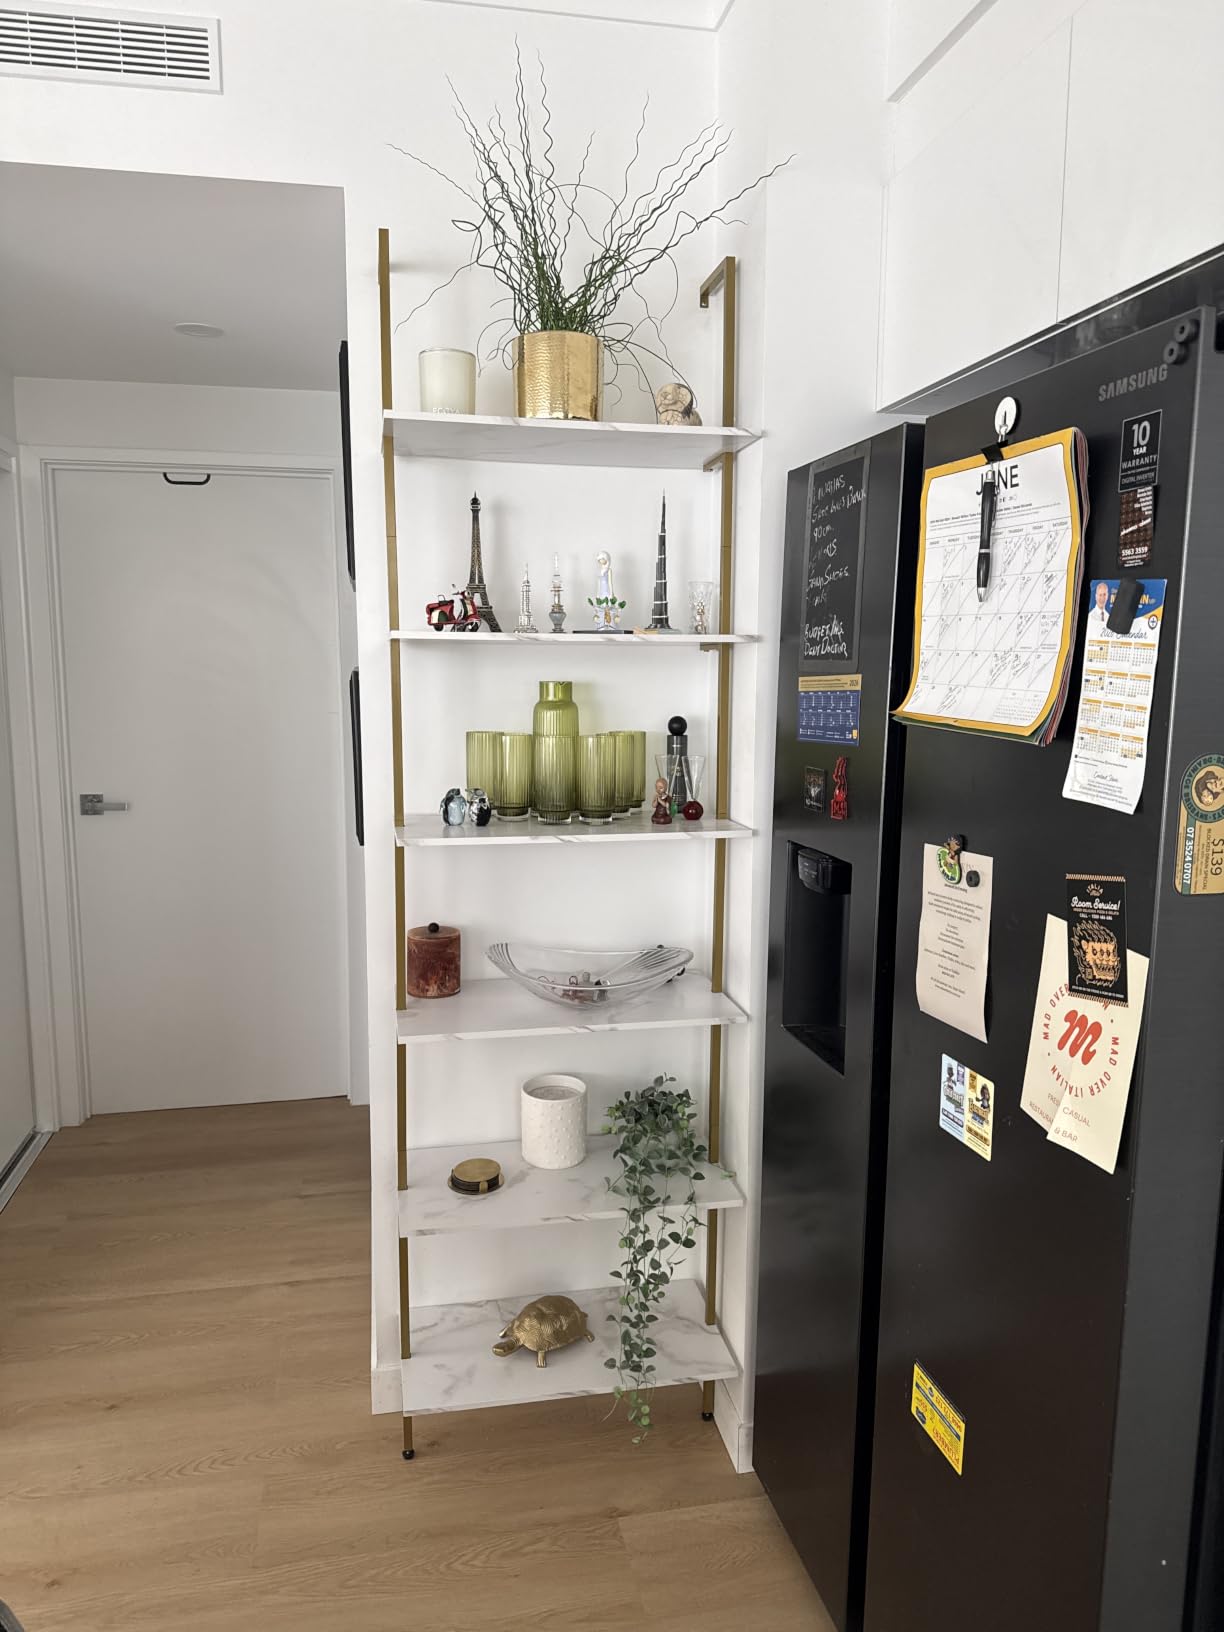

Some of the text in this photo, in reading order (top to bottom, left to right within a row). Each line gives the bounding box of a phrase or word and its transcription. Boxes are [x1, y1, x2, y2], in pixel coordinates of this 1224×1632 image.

[1098, 363, 1168, 401] SAMSUNG
[1131, 420, 1151, 447] 10
[1121, 454, 1158, 470] WARRANTY
[1132, 445, 1147, 456] YEAR
[1183, 826, 1195, 884] 07 3524 0707
[1210, 838, 1224, 876] $139
[1070, 895, 1121, 911] Room Service!
[1043, 983, 1070, 1040] MAD OVER
[1051, 1036, 1119, 1098] MAD OVER ITALIAN
[1062, 1106, 1091, 1127] CASUAL
[1054, 1127, 1078, 1142] & BAR
